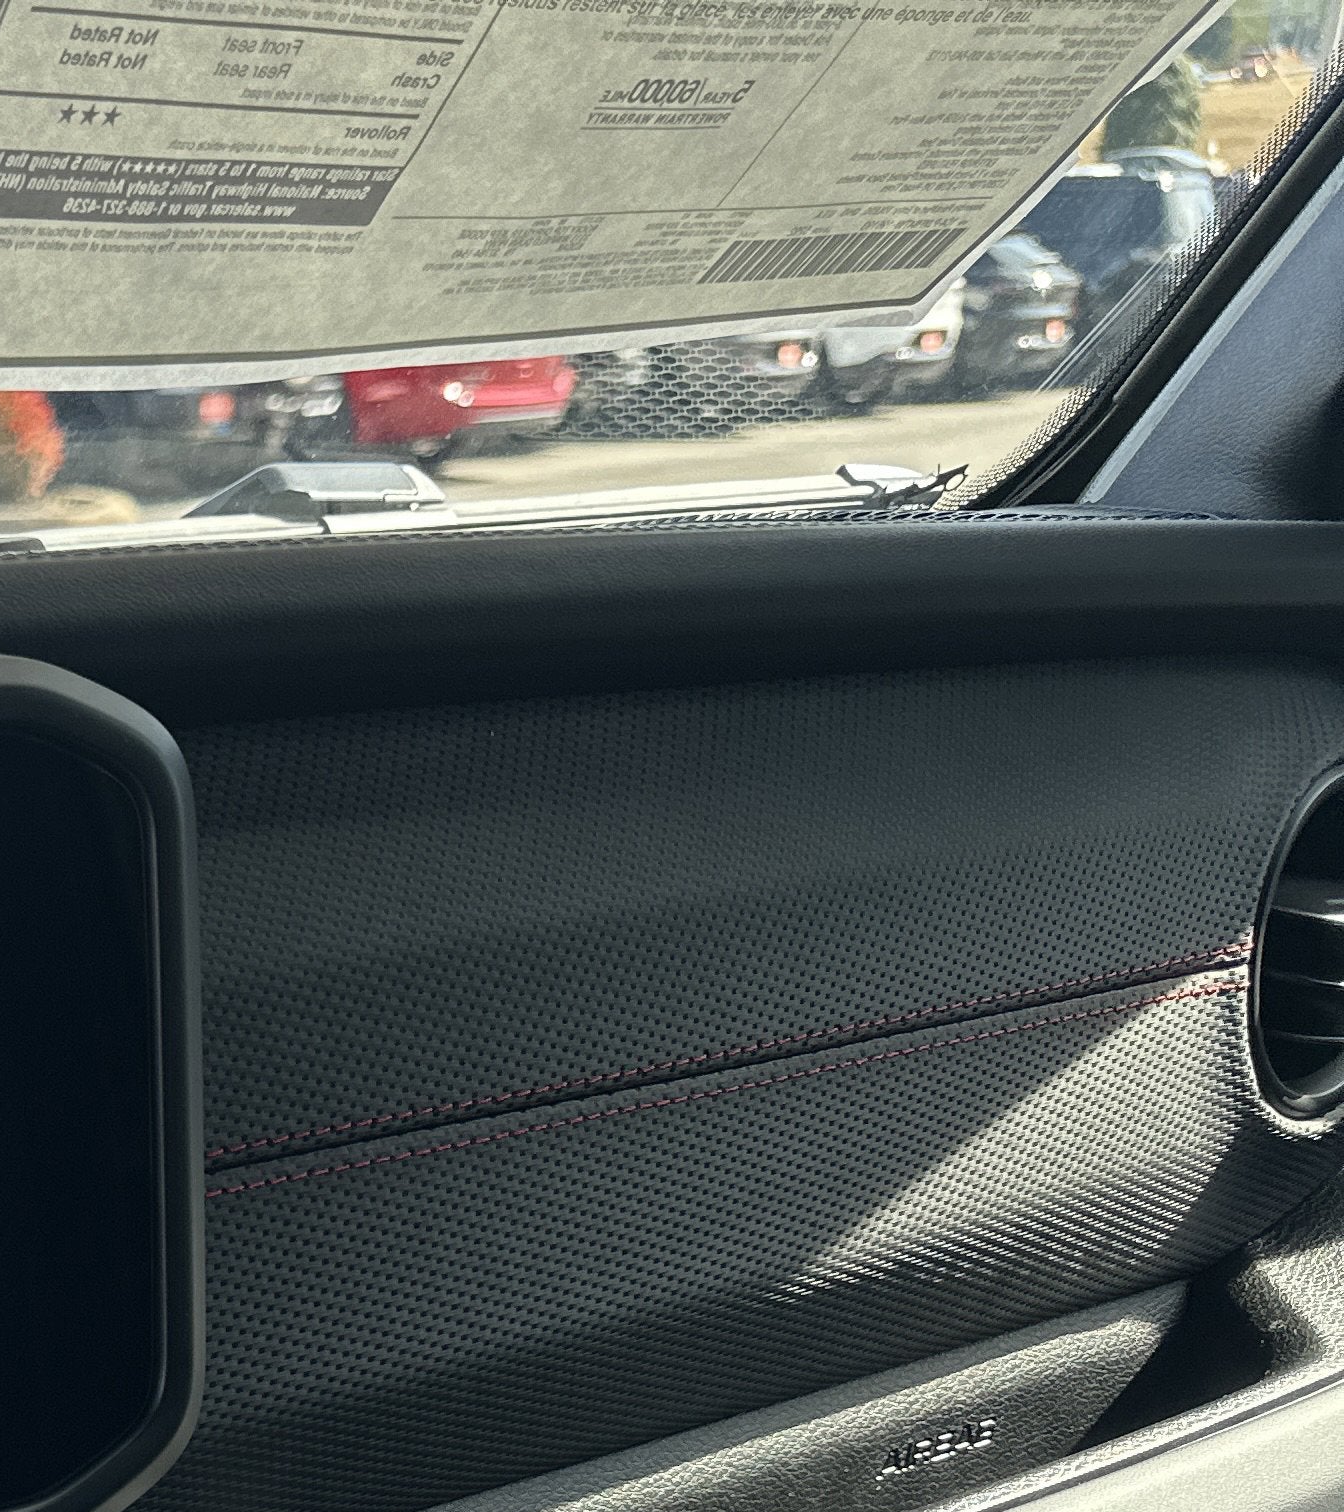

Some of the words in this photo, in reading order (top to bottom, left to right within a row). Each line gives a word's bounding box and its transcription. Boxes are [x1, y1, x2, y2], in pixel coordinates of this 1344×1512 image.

[821, 5, 860, 19] avec
[862, 6, 893, 21] une
[894, 5, 954, 26] éponge
[954, 8, 972, 23] et
[973, 7, 993, 23] de
